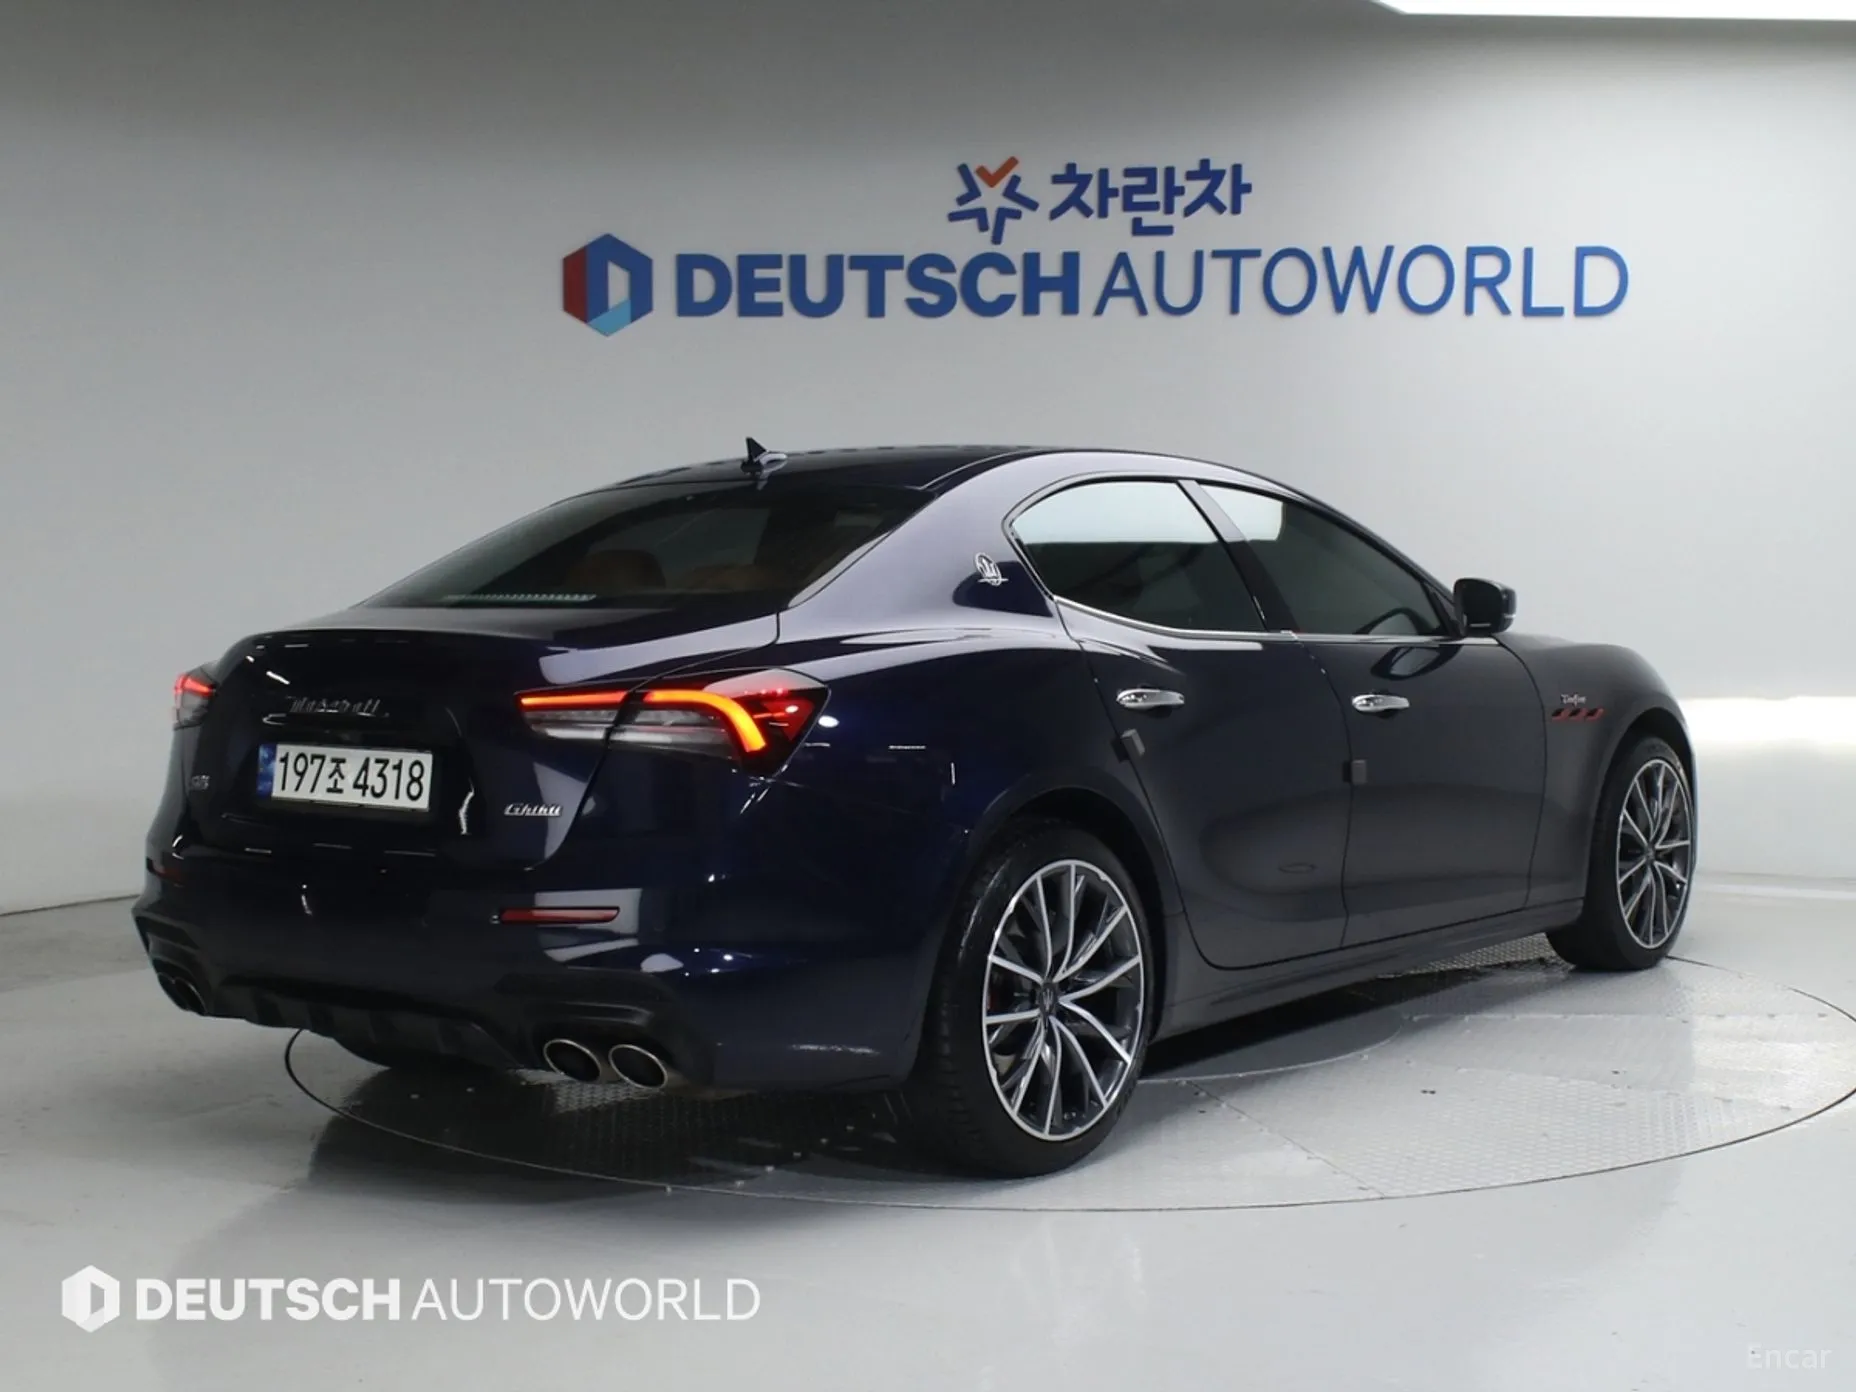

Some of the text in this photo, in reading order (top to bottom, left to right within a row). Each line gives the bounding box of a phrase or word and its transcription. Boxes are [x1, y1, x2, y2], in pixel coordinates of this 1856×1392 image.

[1050, 158, 1252, 236] 차란차
[675, 244, 1630, 318] DEUTSCH AUTOWORLD
